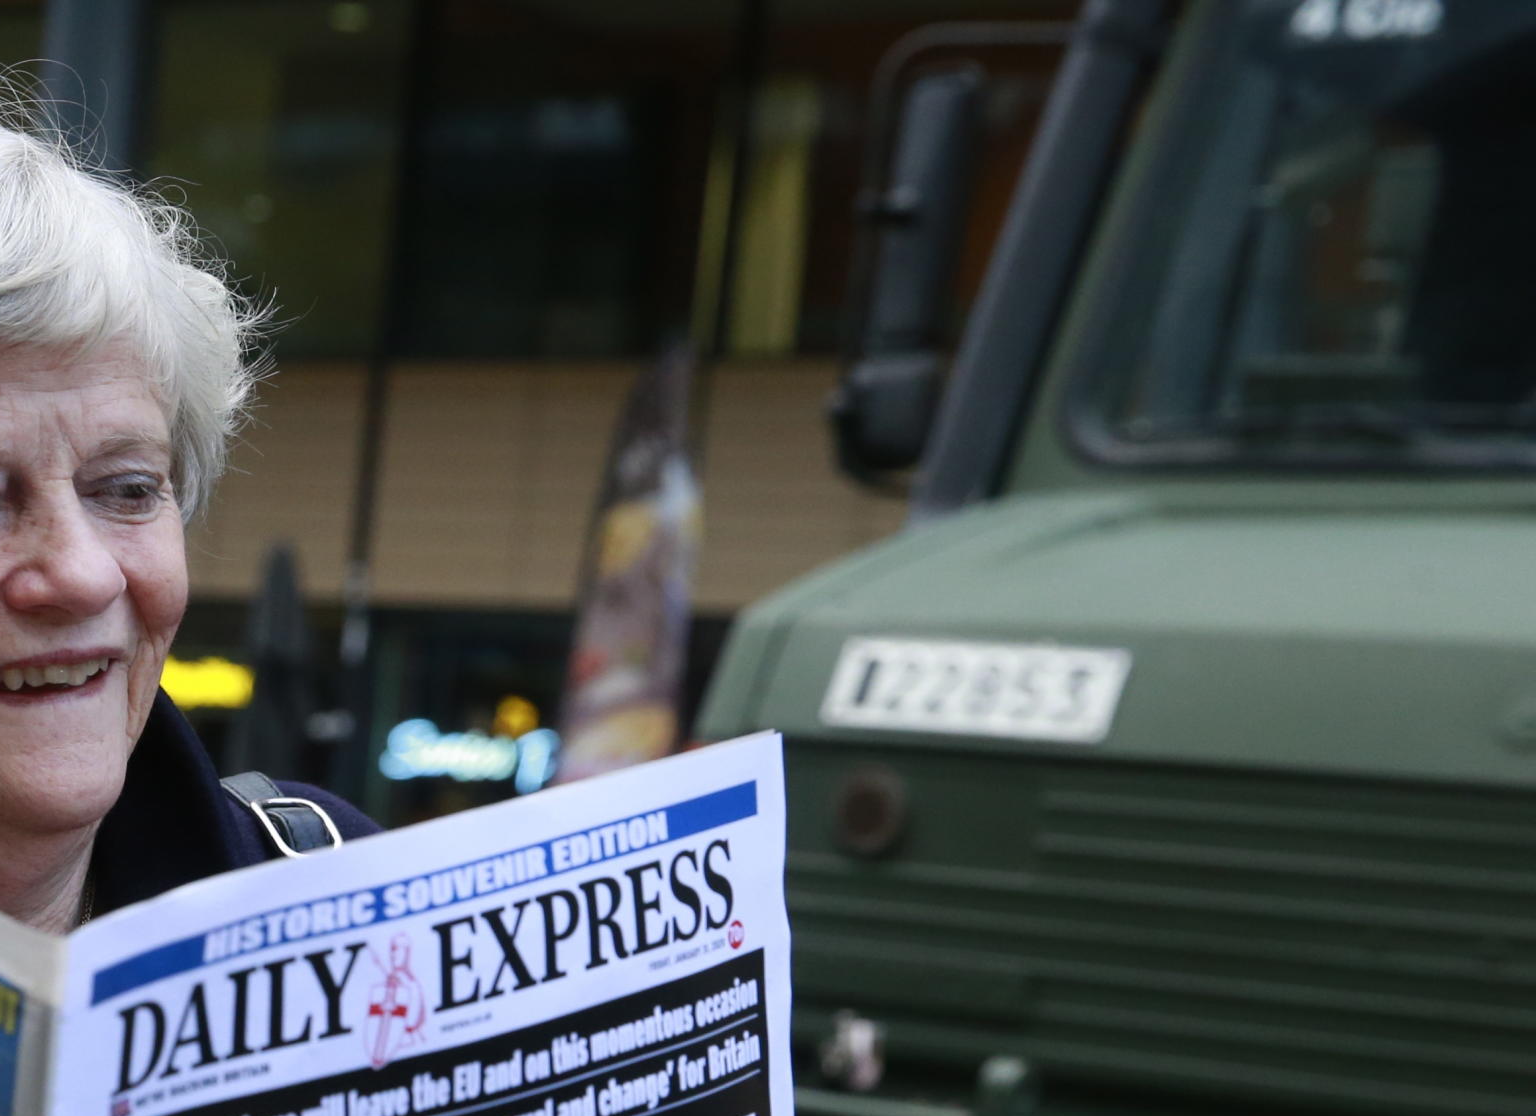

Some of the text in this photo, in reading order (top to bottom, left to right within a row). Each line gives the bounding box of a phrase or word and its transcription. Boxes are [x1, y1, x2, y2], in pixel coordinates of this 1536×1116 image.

[203, 811, 670, 963] HISTORIC SOUVENIR EDITION
[113, 943, 367, 1096] DAILY
[432, 839, 733, 1013] EXPRESS
[413, 1071, 451, 1111] the
[453, 1061, 482, 1101] EU
[484, 1049, 522, 1094] and
[524, 1049, 551, 1082] on
[552, 1032, 589, 1074] this
[590, 1005, 694, 1061] momentous
[695, 977, 758, 1026] occasion
[678, 1055, 706, 1091] for
[709, 1030, 761, 1080] Britain
